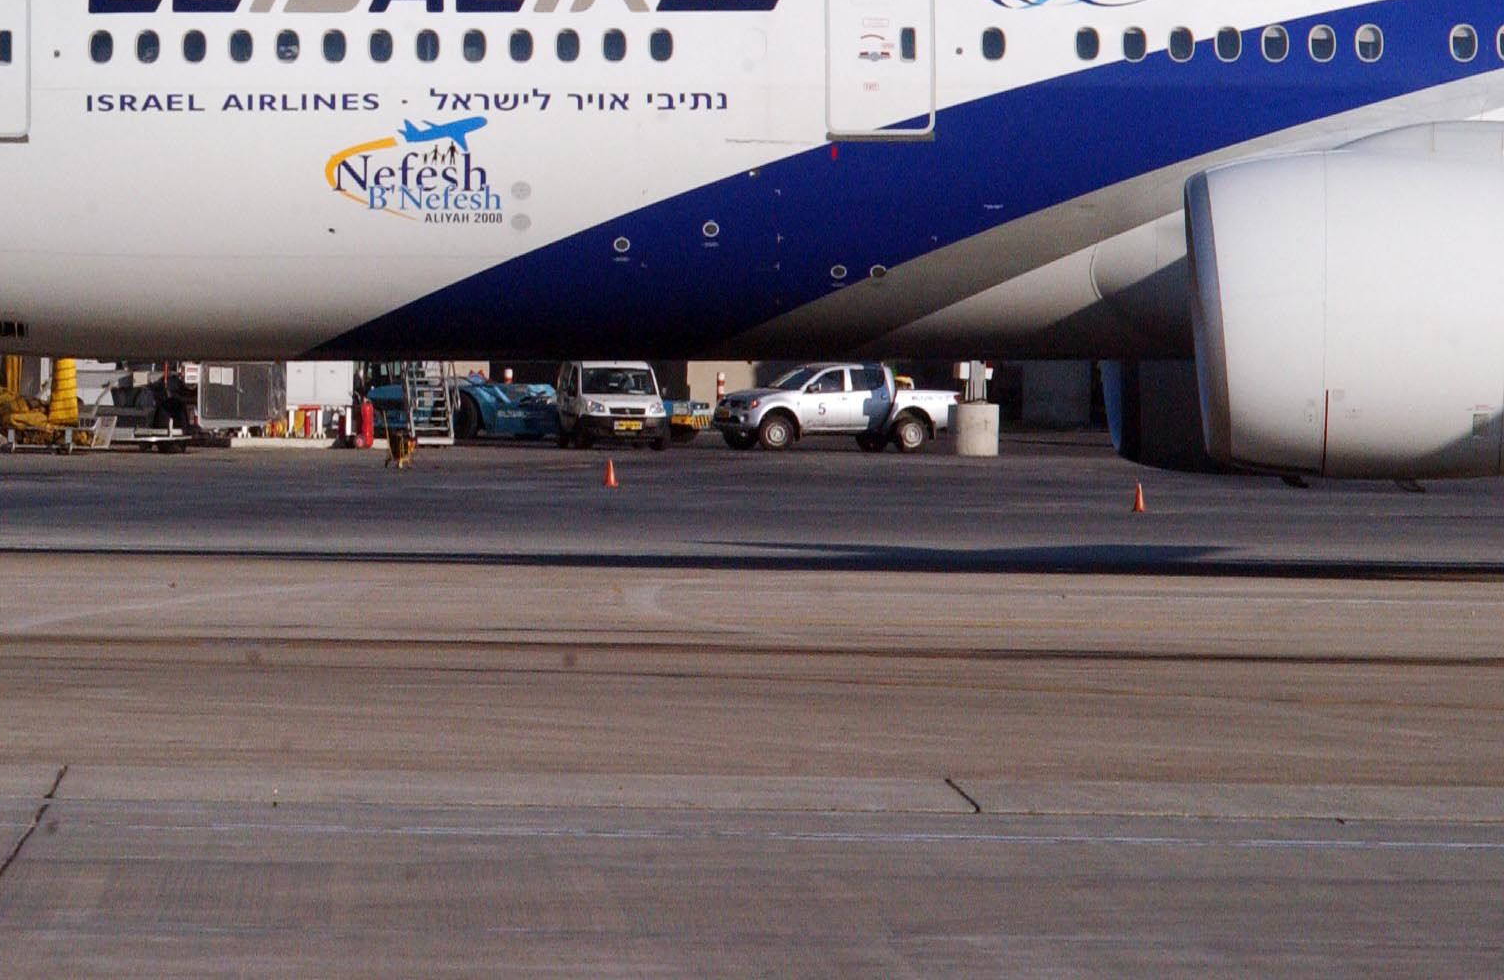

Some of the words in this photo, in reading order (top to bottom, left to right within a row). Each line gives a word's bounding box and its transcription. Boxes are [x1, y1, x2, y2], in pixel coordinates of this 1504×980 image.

[85, 91, 206, 112] ISRAEL
[221, 91, 381, 112] AIRLINES
[429, 87, 552, 111] לישראל
[567, 92, 630, 110] אויר
[646, 91, 728, 111] נתיבי
[335, 152, 487, 193] Nefesh
[367, 184, 502, 211] B'Nefesh
[424, 212, 470, 224] ALIYAH
[817, 402, 827, 416] 5
